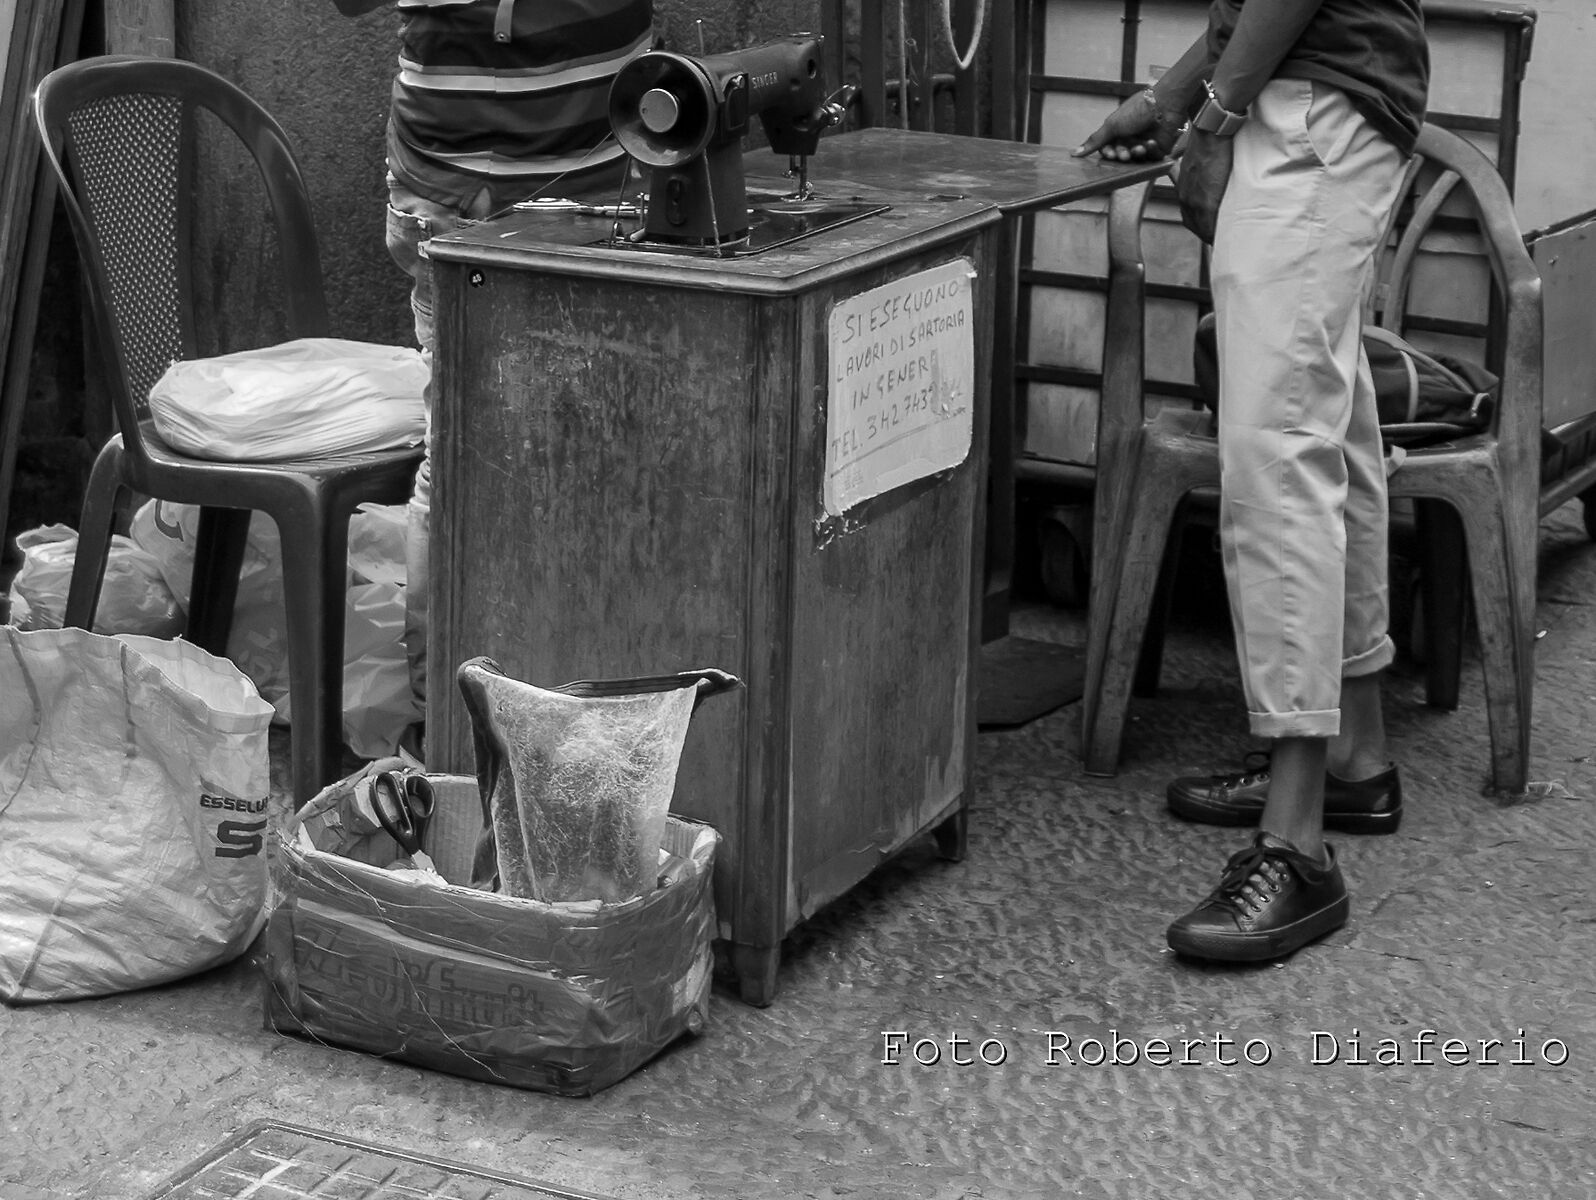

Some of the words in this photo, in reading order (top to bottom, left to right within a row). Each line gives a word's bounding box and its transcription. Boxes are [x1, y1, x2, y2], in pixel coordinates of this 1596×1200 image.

[752, 71, 778, 89] SINGER
[842, 312, 862, 344] SI
[869, 279, 959, 333] ESEGUONO
[836, 341, 884, 383] LAVORI
[890, 335, 904, 356] DI
[908, 308, 965, 348] SARTORIA
[852, 381, 871, 411] IN
[831, 428, 864, 462] TEL.
[200, 793, 268, 813] ESSELU
